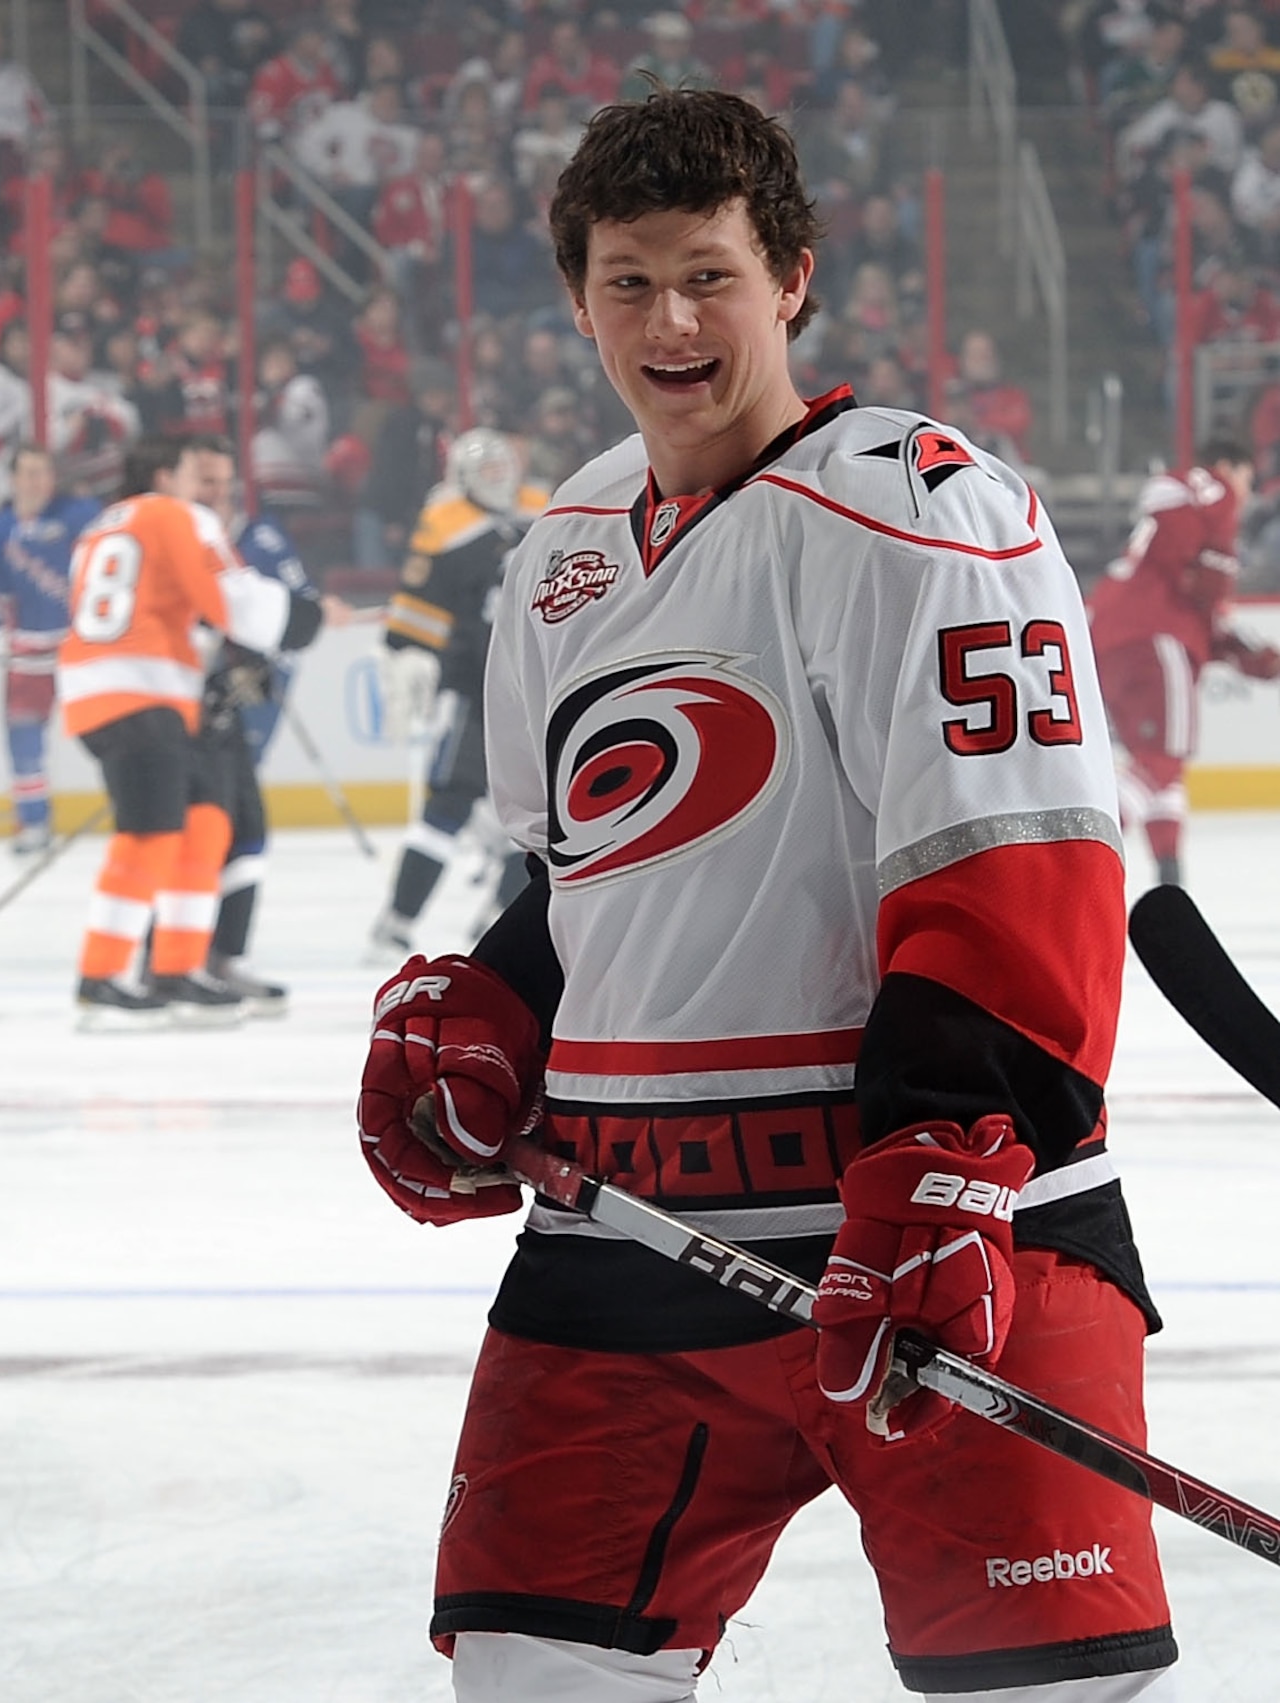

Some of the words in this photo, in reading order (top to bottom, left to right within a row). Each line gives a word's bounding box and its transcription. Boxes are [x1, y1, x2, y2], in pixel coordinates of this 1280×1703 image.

[68, 532, 144, 645] 8
[576, 567, 618, 588] STAR
[937, 619, 1082, 757] 53
[985, 1543, 1114, 1588] Reebok
